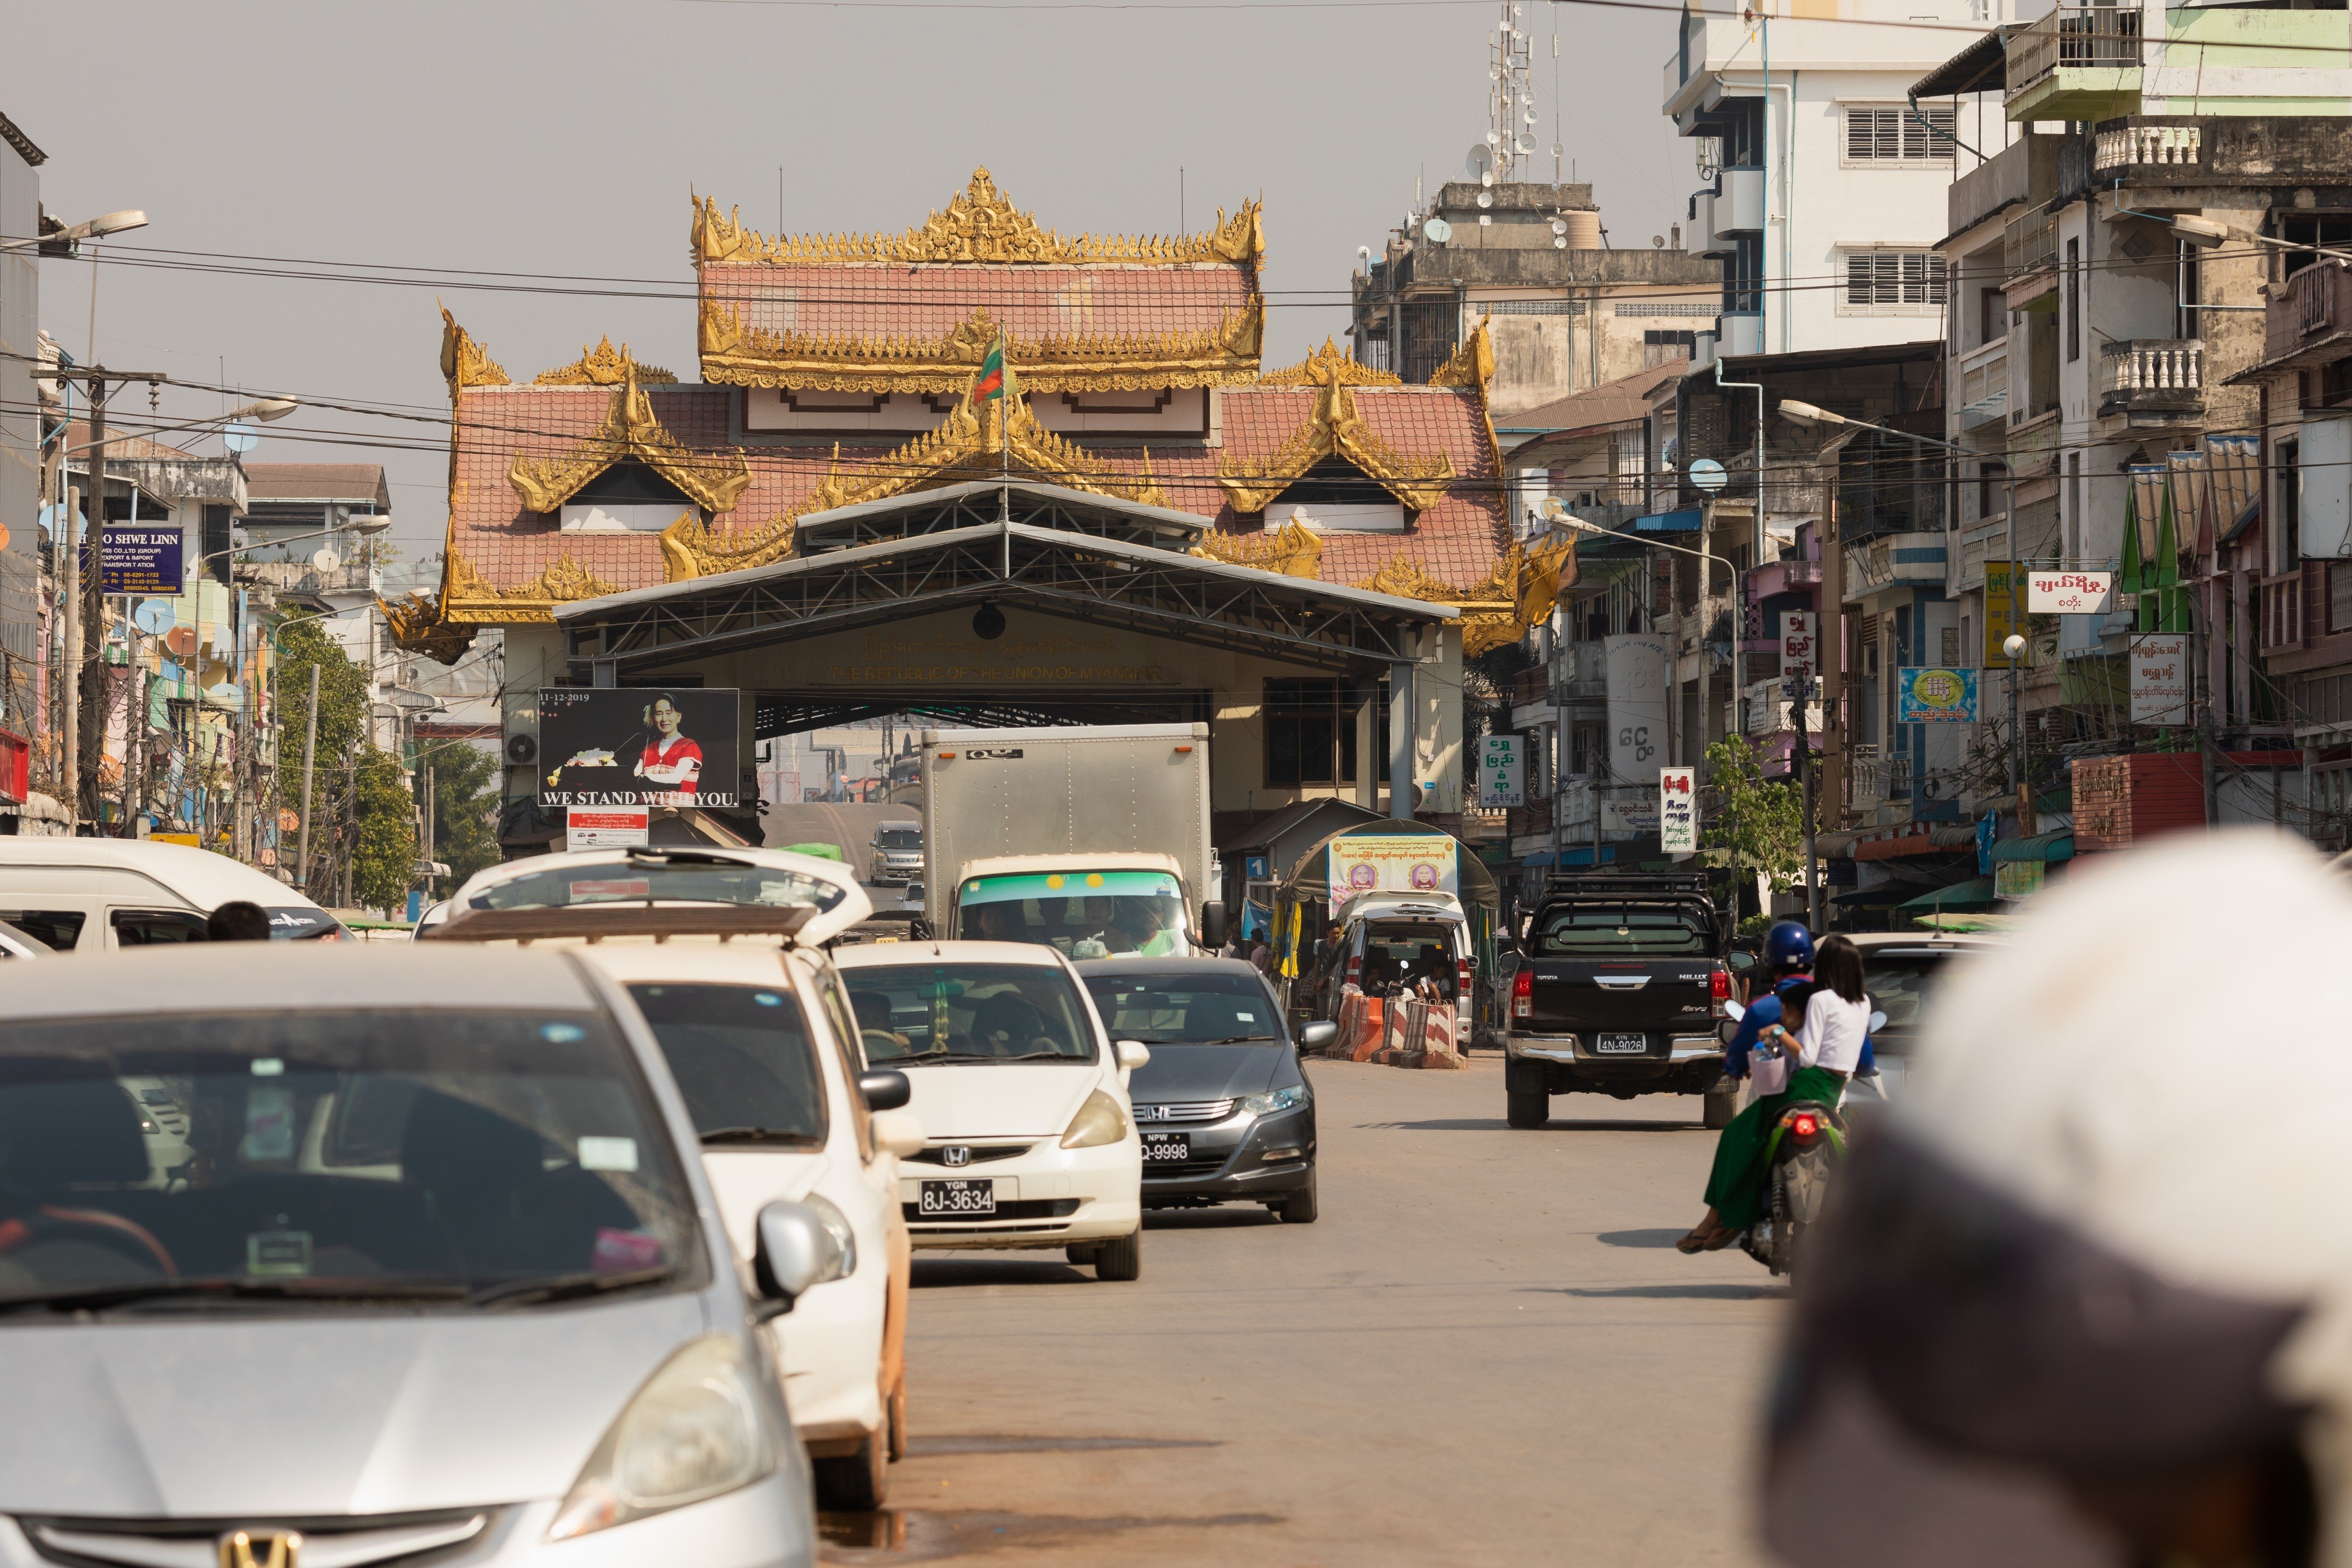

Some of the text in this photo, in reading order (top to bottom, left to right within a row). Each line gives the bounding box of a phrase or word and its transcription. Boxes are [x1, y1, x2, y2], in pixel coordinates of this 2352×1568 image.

[115, 534, 148, 544] SHWE
[150, 534, 178, 544] LINN
[828, 665, 1162, 681] THE REPUBLIC OF THE UNION OF MYANMAR
[539, 693, 590, 702] 11-12-2019
[1486, 753, 1516, 768] ပြည်
[543, 791, 738, 806] WE STAND WITH YOU.
[1252, 859, 1262, 875] 1
[1602, 1041, 1642, 1051] 4N-9026
[1148, 1134, 1168, 1142] NPW
[945, 1180, 968, 1190] YGN
[924, 1189, 992, 1210] 8J-3634
